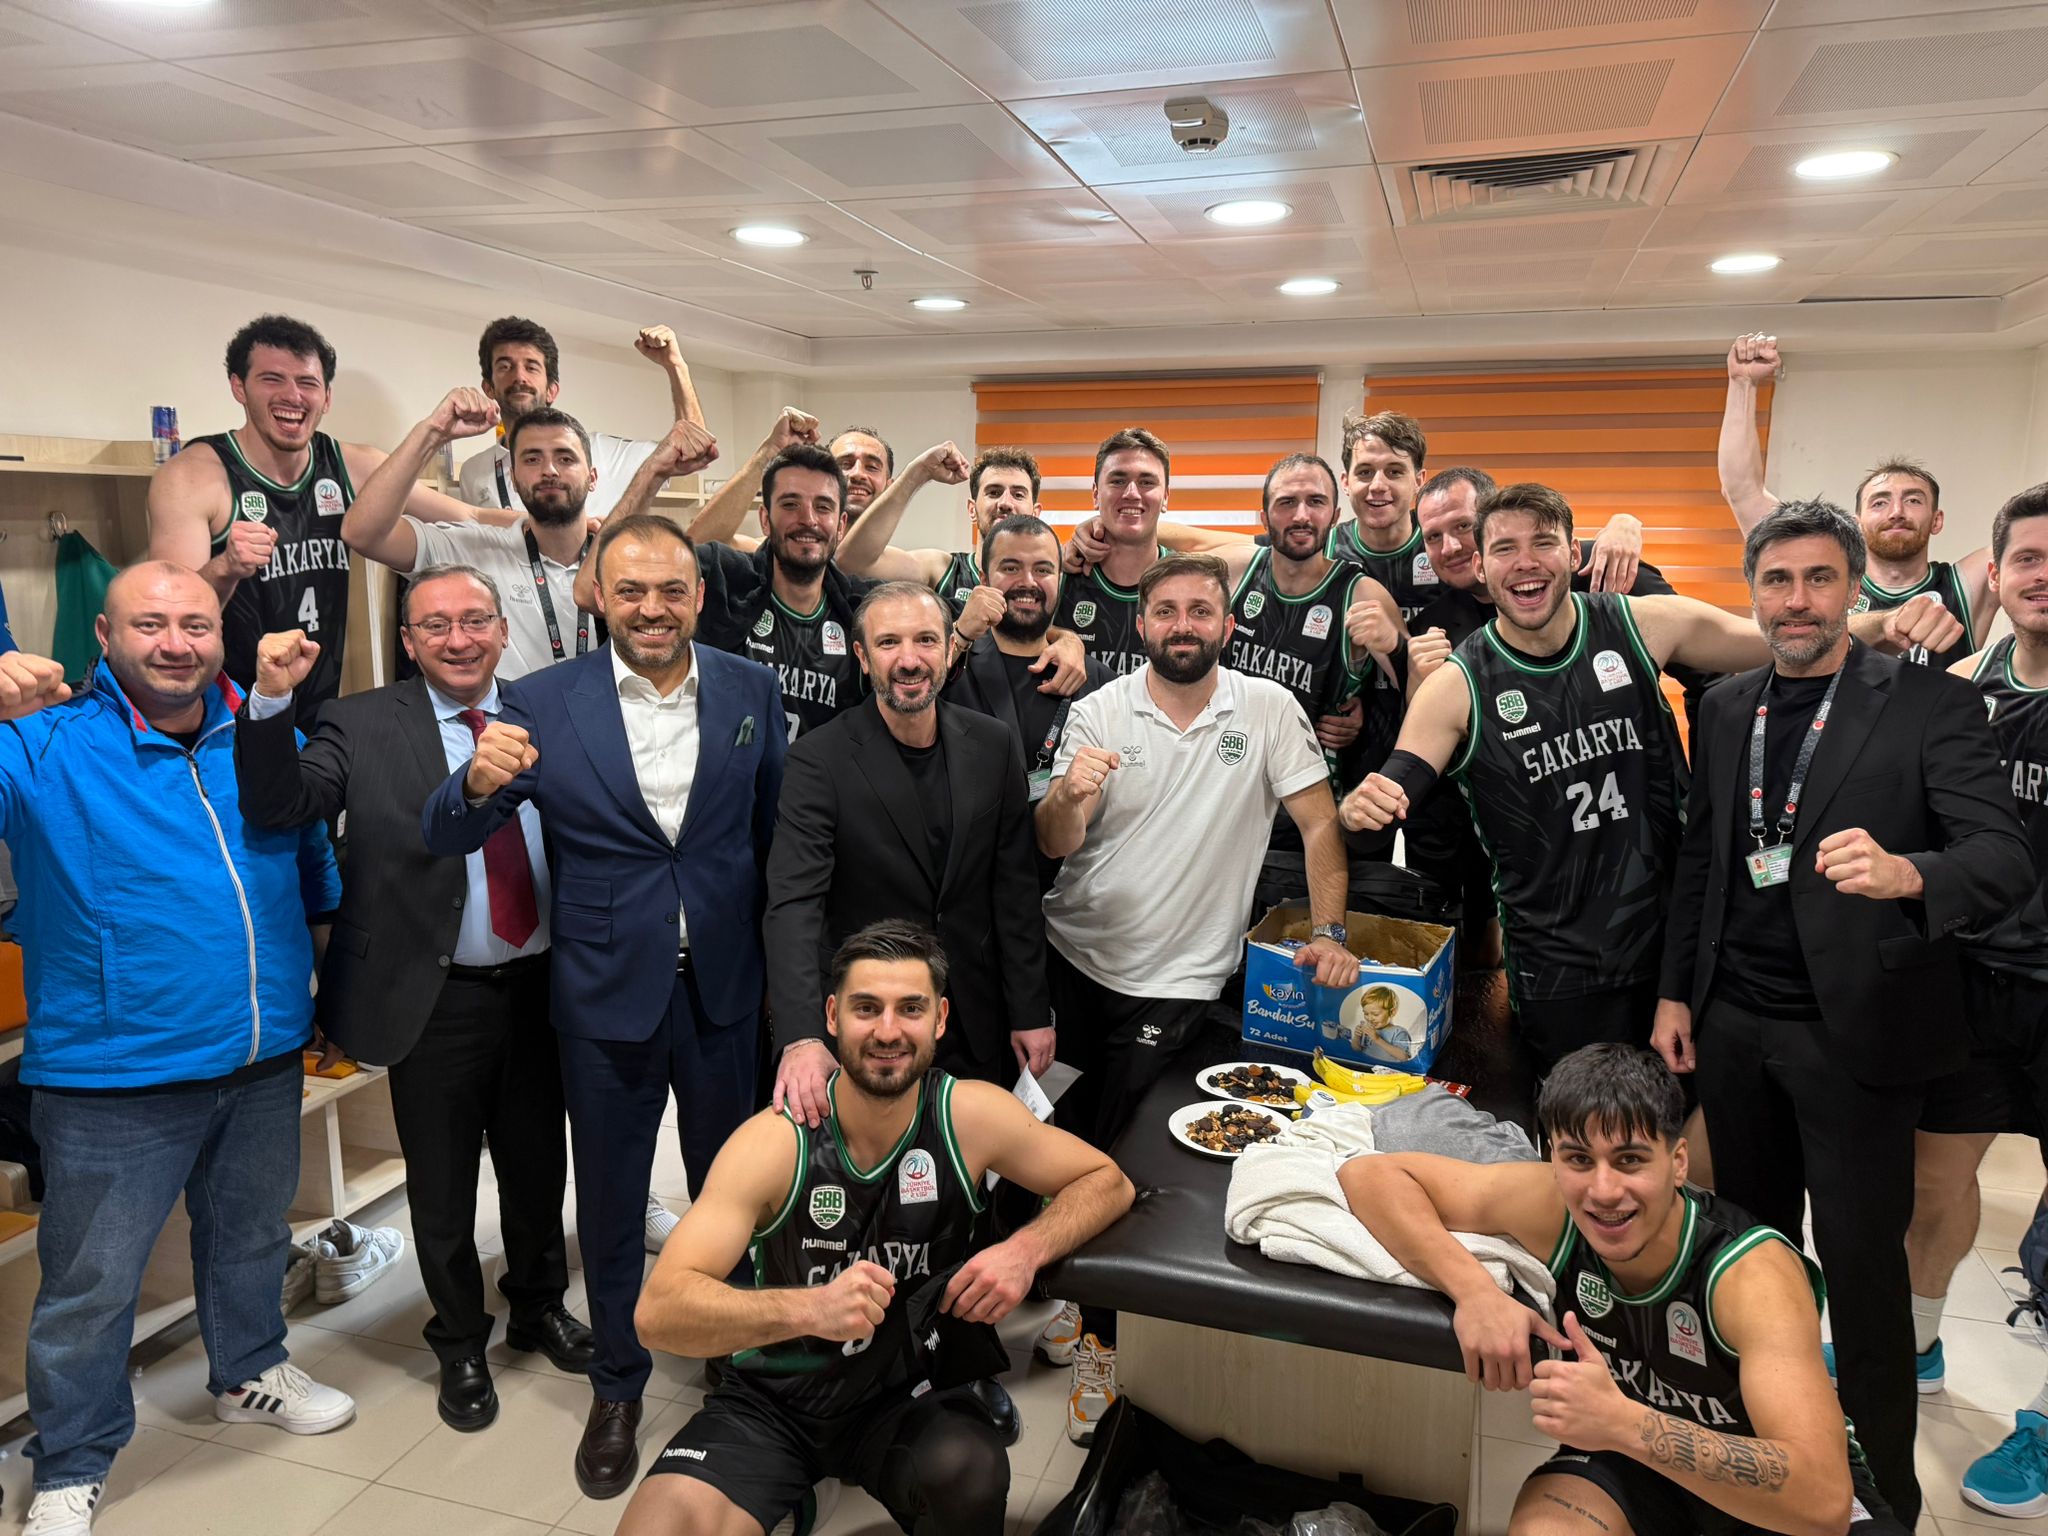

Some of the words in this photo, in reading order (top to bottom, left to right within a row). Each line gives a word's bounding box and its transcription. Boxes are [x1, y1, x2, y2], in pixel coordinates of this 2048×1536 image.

[244, 495, 265, 509] SBB
[298, 586, 320, 633] 4
[1075, 603, 1094, 616] SBB
[1246, 593, 1263, 608] SBB
[1234, 623, 1256, 637] ummel
[745, 635, 775, 654] hummel
[1231, 640, 1313, 694] SAKARYA
[1499, 693, 1525, 712] SBB
[1502, 721, 1542, 742] hummel
[1220, 735, 1244, 751] SBB
[1522, 717, 1644, 784] SAKARYA
[1565, 770, 1630, 833] 24
[1249, 1027, 1261, 1037] 72
[1263, 1032, 1288, 1043] Adet
[812, 1190, 843, 1209] SBB
[801, 1236, 847, 1251] hummel
[1579, 1276, 1611, 1302] SBB
[661, 1447, 708, 1461] hummel
